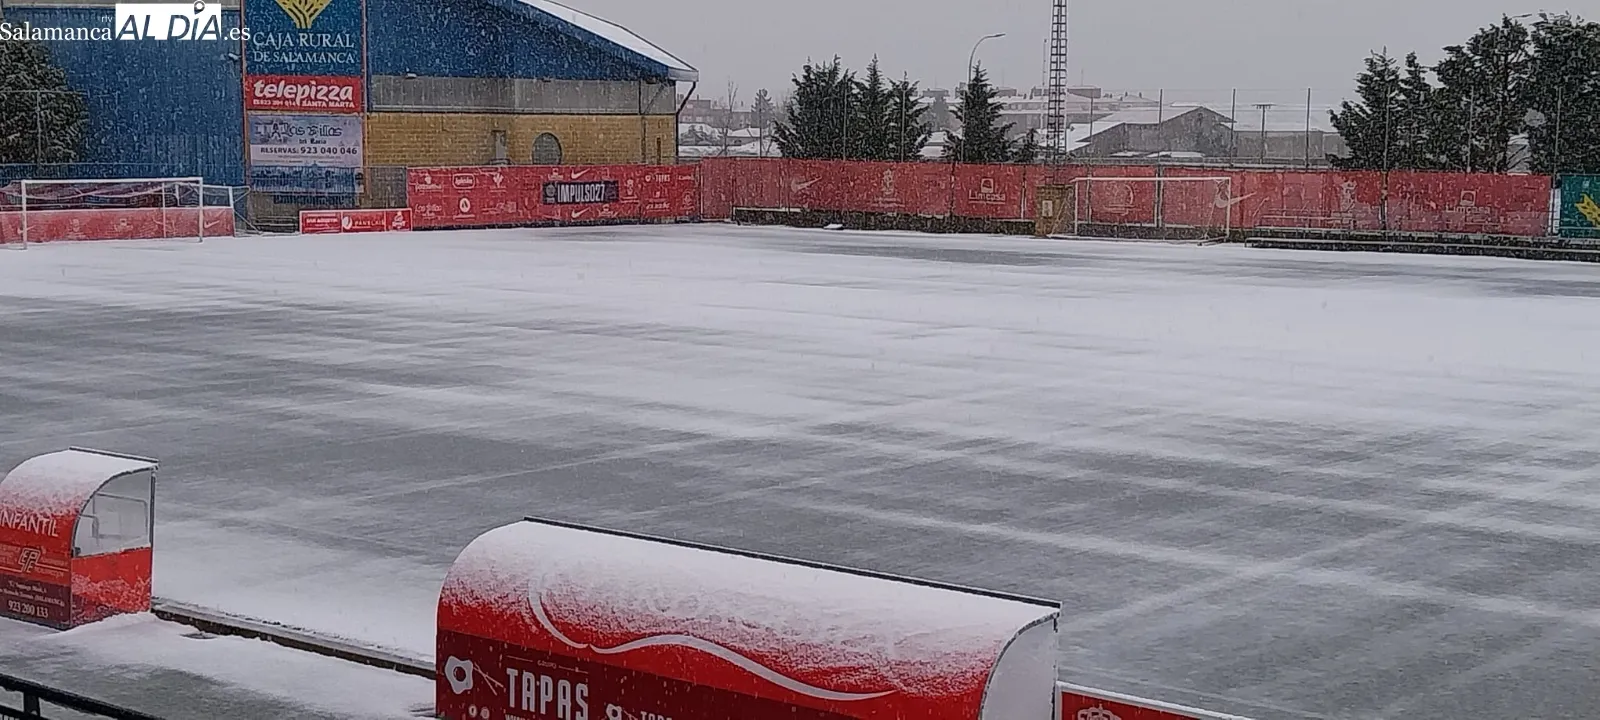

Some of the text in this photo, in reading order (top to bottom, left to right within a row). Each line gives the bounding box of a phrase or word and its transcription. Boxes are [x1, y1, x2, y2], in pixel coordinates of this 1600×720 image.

[253, 32, 355, 49] CAJA RURAL
[254, 51, 355, 64] DE SALAMANCA
[253, 80, 354, 106] telepizza
[302, 99, 327, 108] SANTA
[329, 100, 355, 109] MARTA
[300, 146, 317, 154] 923
[320, 147, 338, 155] 040
[340, 147, 358, 155] 046
[557, 183, 606, 203] IMPULSO27
[0, 510, 59, 537] INFANTIL
[8, 600, 49, 619] 923 200 133
[506, 667, 589, 720] TAPAS
